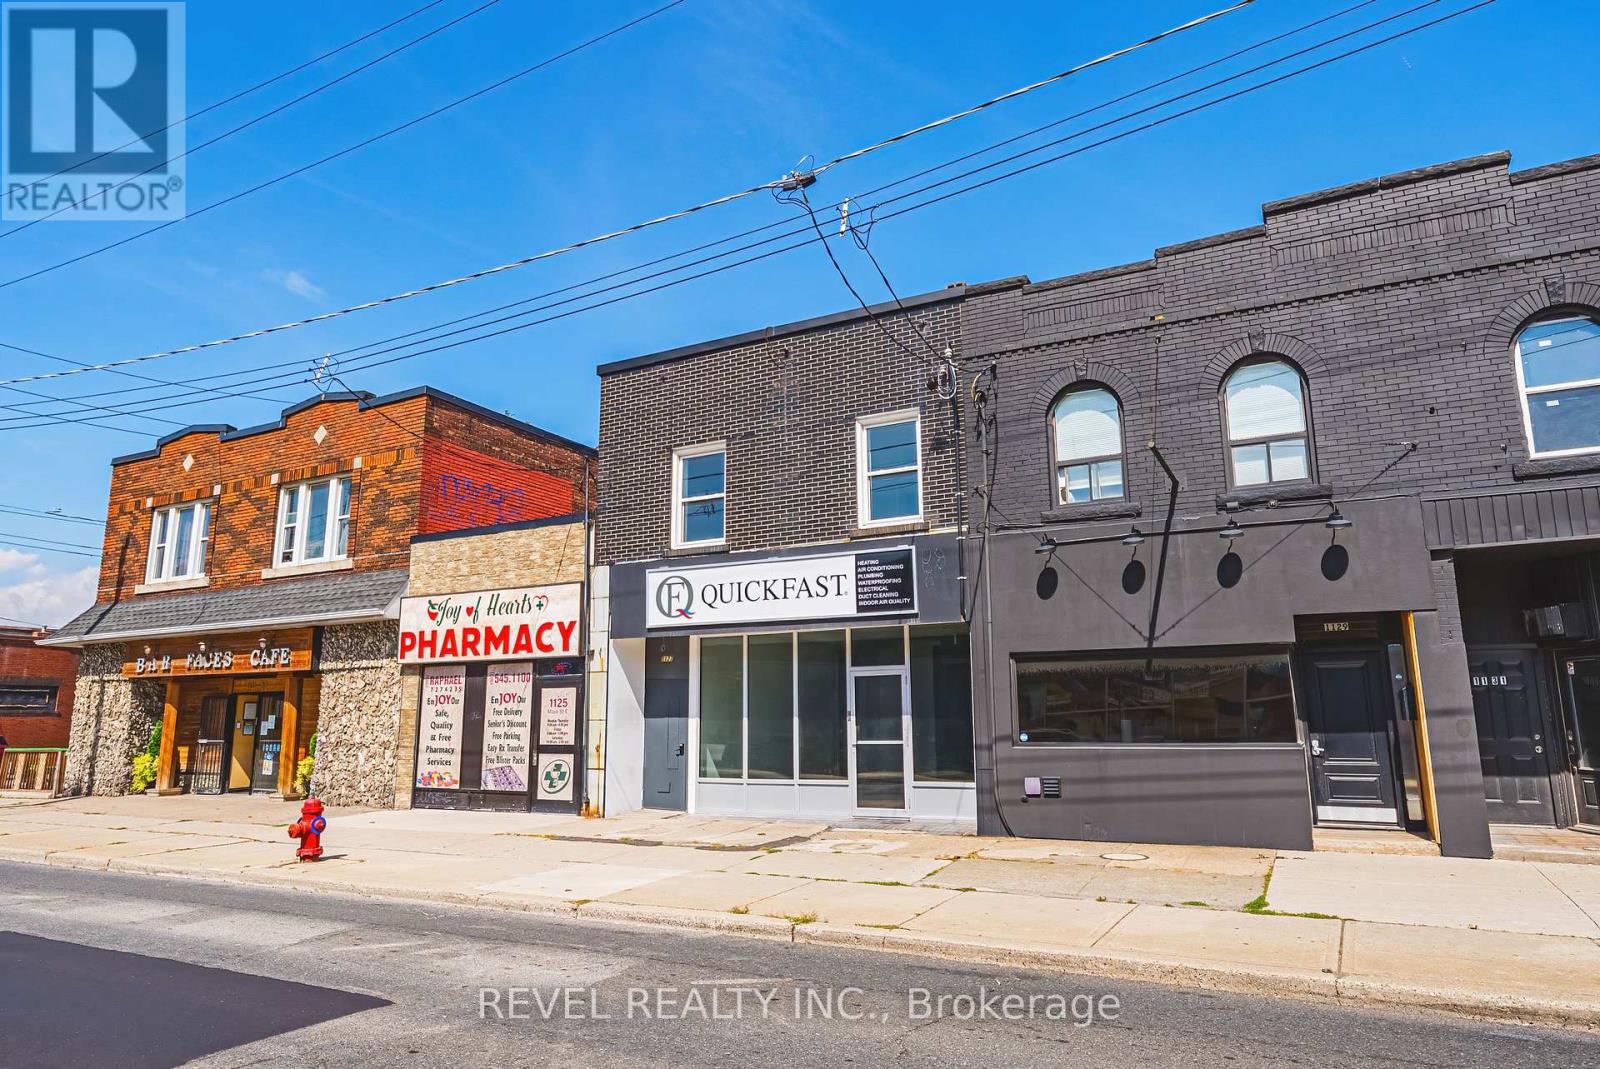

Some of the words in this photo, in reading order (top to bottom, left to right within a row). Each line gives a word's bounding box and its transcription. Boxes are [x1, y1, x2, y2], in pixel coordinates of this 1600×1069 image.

[867, 564, 904, 572] CONDITIONING
[857, 577, 902, 586] WATERPROOFING
[701, 574, 847, 609] QUICKFAST
[858, 585, 889, 593] ELECTRICAL
[872, 591, 899, 599] CLEANING
[437, 597, 462, 627] Joy
[487, 593, 532, 618] Hearts
[1323, 622, 1349, 632] 1129
[400, 620, 577, 660] PHARMACY
[250, 647, 291, 667] CAFE
[430, 674, 462, 686] RAPHAEL
[1472, 675, 1507, 686] 1131
[549, 697, 568, 708] 1125
[435, 709, 449, 718] Safe,
[492, 707, 503, 716] Free
[504, 707, 523, 718] Delivery
[430, 721, 454, 731] Quality
[506, 719, 528, 728] Discount
[438, 733, 452, 742] Free
[492, 731, 502, 740] Free
[503, 731, 521, 741] Parking
[425, 745, 455, 755] Pharmacy
[487, 743, 497, 754] Easy
[498, 743, 505, 752] Rx
[506, 743, 525, 752] Transfer
[427, 757, 452, 766] Services
[485, 755, 495, 764] Free
[512, 755, 526, 765] Packs
